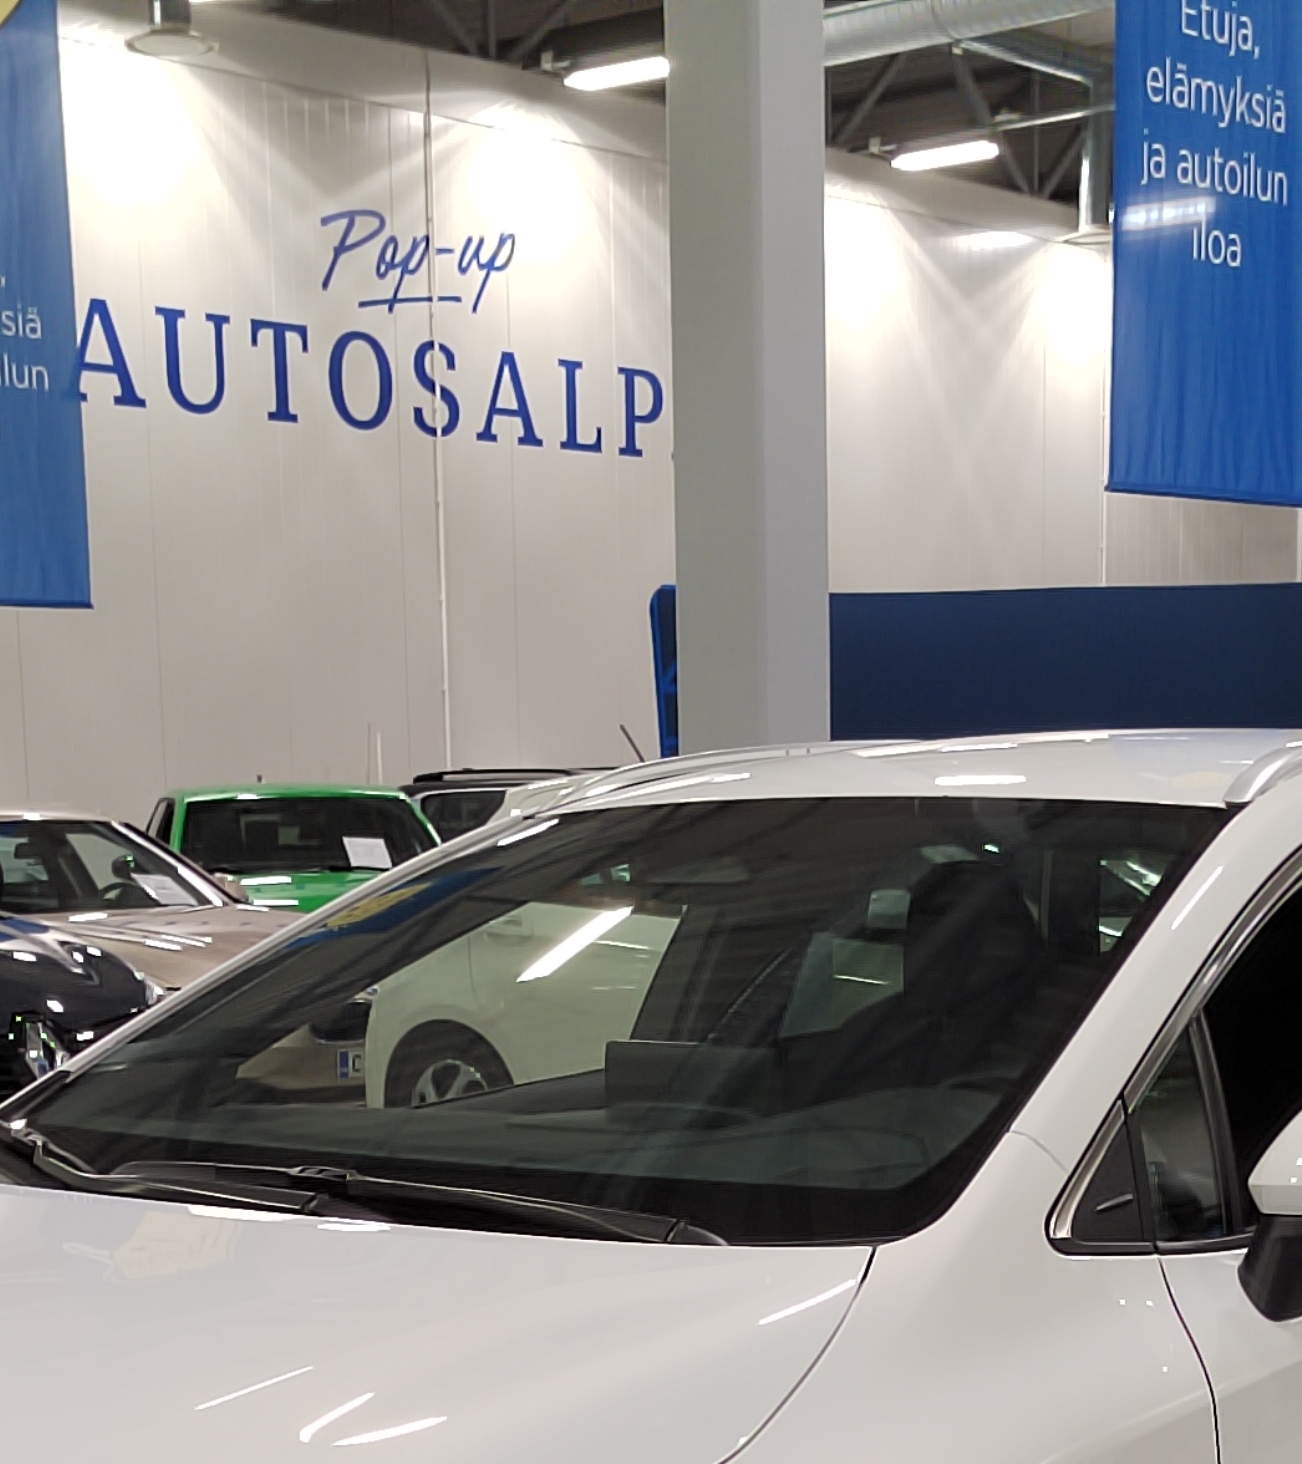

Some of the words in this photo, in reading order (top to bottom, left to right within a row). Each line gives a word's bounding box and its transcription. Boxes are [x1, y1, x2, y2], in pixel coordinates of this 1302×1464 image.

[1181, 0, 1260, 60] Etuja,
[1146, 56, 1287, 134] elämyksiä
[1140, 127, 1166, 186] ja
[1176, 147, 1288, 206] autoilun
[320, 209, 516, 315] Pop-up
[1192, 214, 1242, 268] iloa
[77, 298, 665, 459] AUTOSALP
